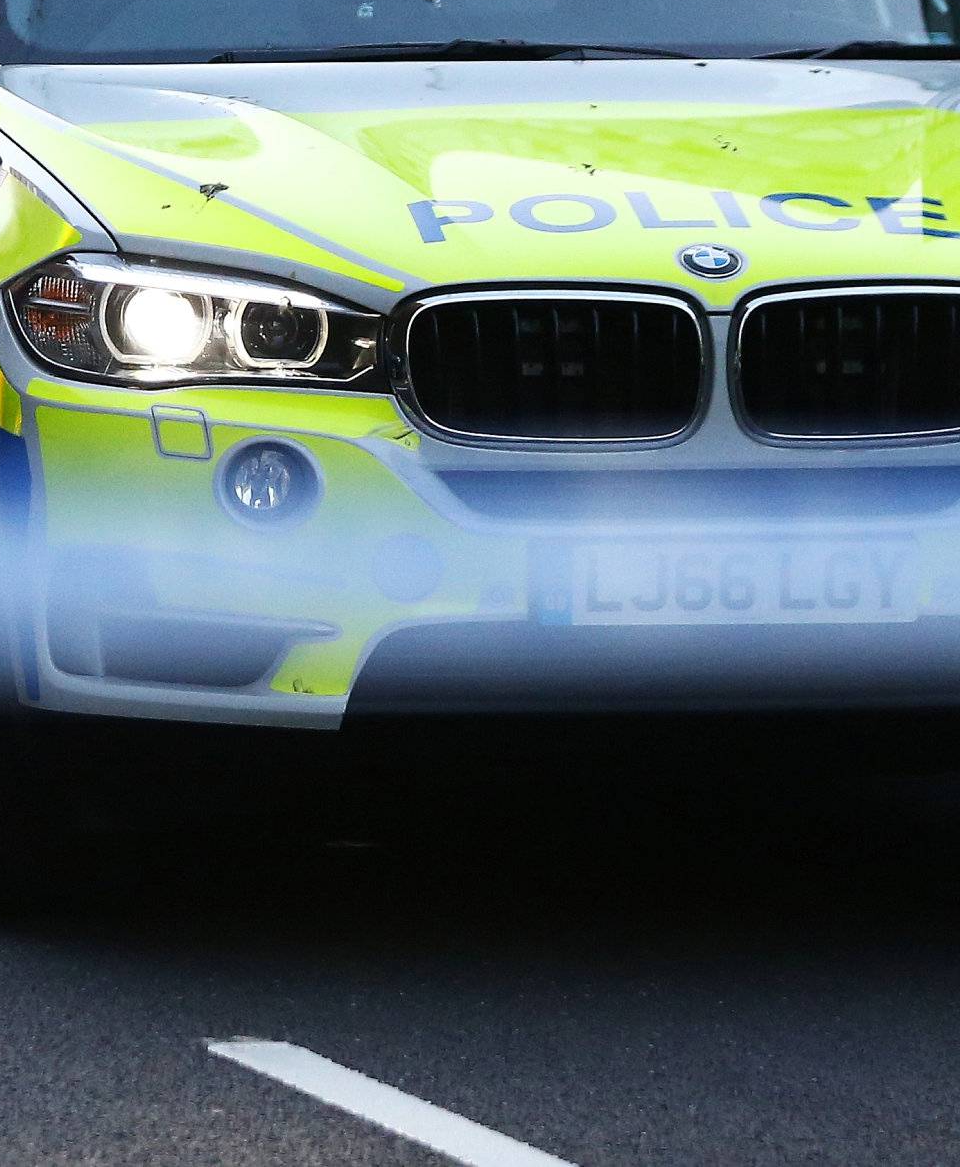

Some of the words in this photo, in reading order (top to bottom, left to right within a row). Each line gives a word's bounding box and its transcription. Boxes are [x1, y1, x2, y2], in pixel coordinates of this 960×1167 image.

[407, 192, 960, 243] POLICE
[585, 551, 755, 612] LJ66
[778, 548, 908, 611] LGY
